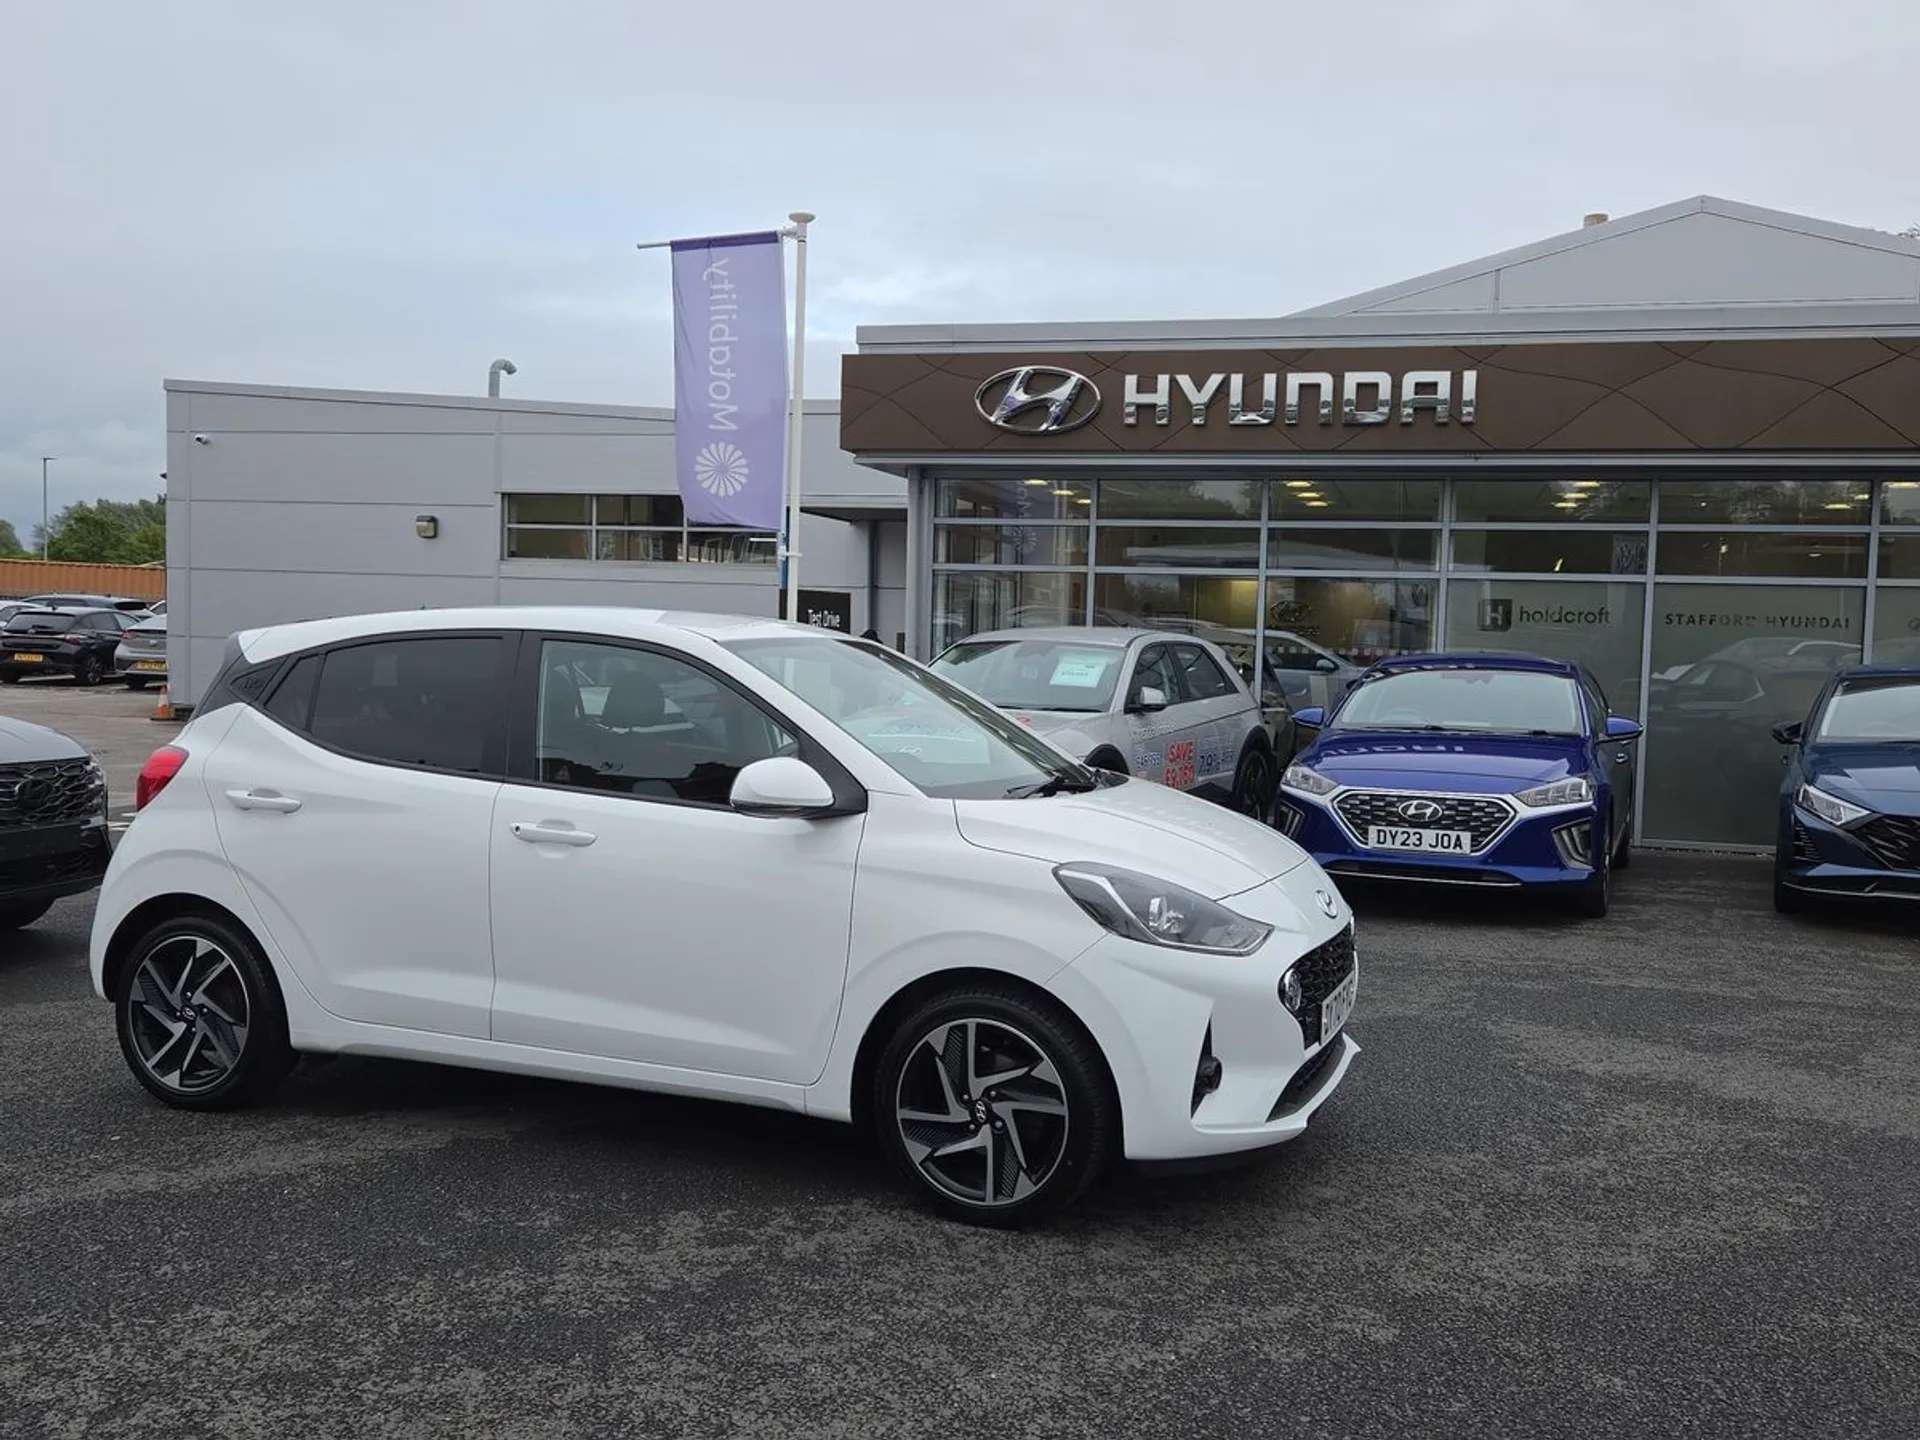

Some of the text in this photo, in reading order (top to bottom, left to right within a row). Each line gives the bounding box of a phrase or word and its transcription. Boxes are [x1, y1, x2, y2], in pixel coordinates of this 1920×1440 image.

[1123, 369, 1478, 426] HYUNDAI
[1519, 605, 1611, 625] holdcroft
[1766, 616, 1849, 629] HYUNDAI
[1167, 741, 1194, 761] SAVE
[1376, 829, 1463, 850] DY23 JOA
